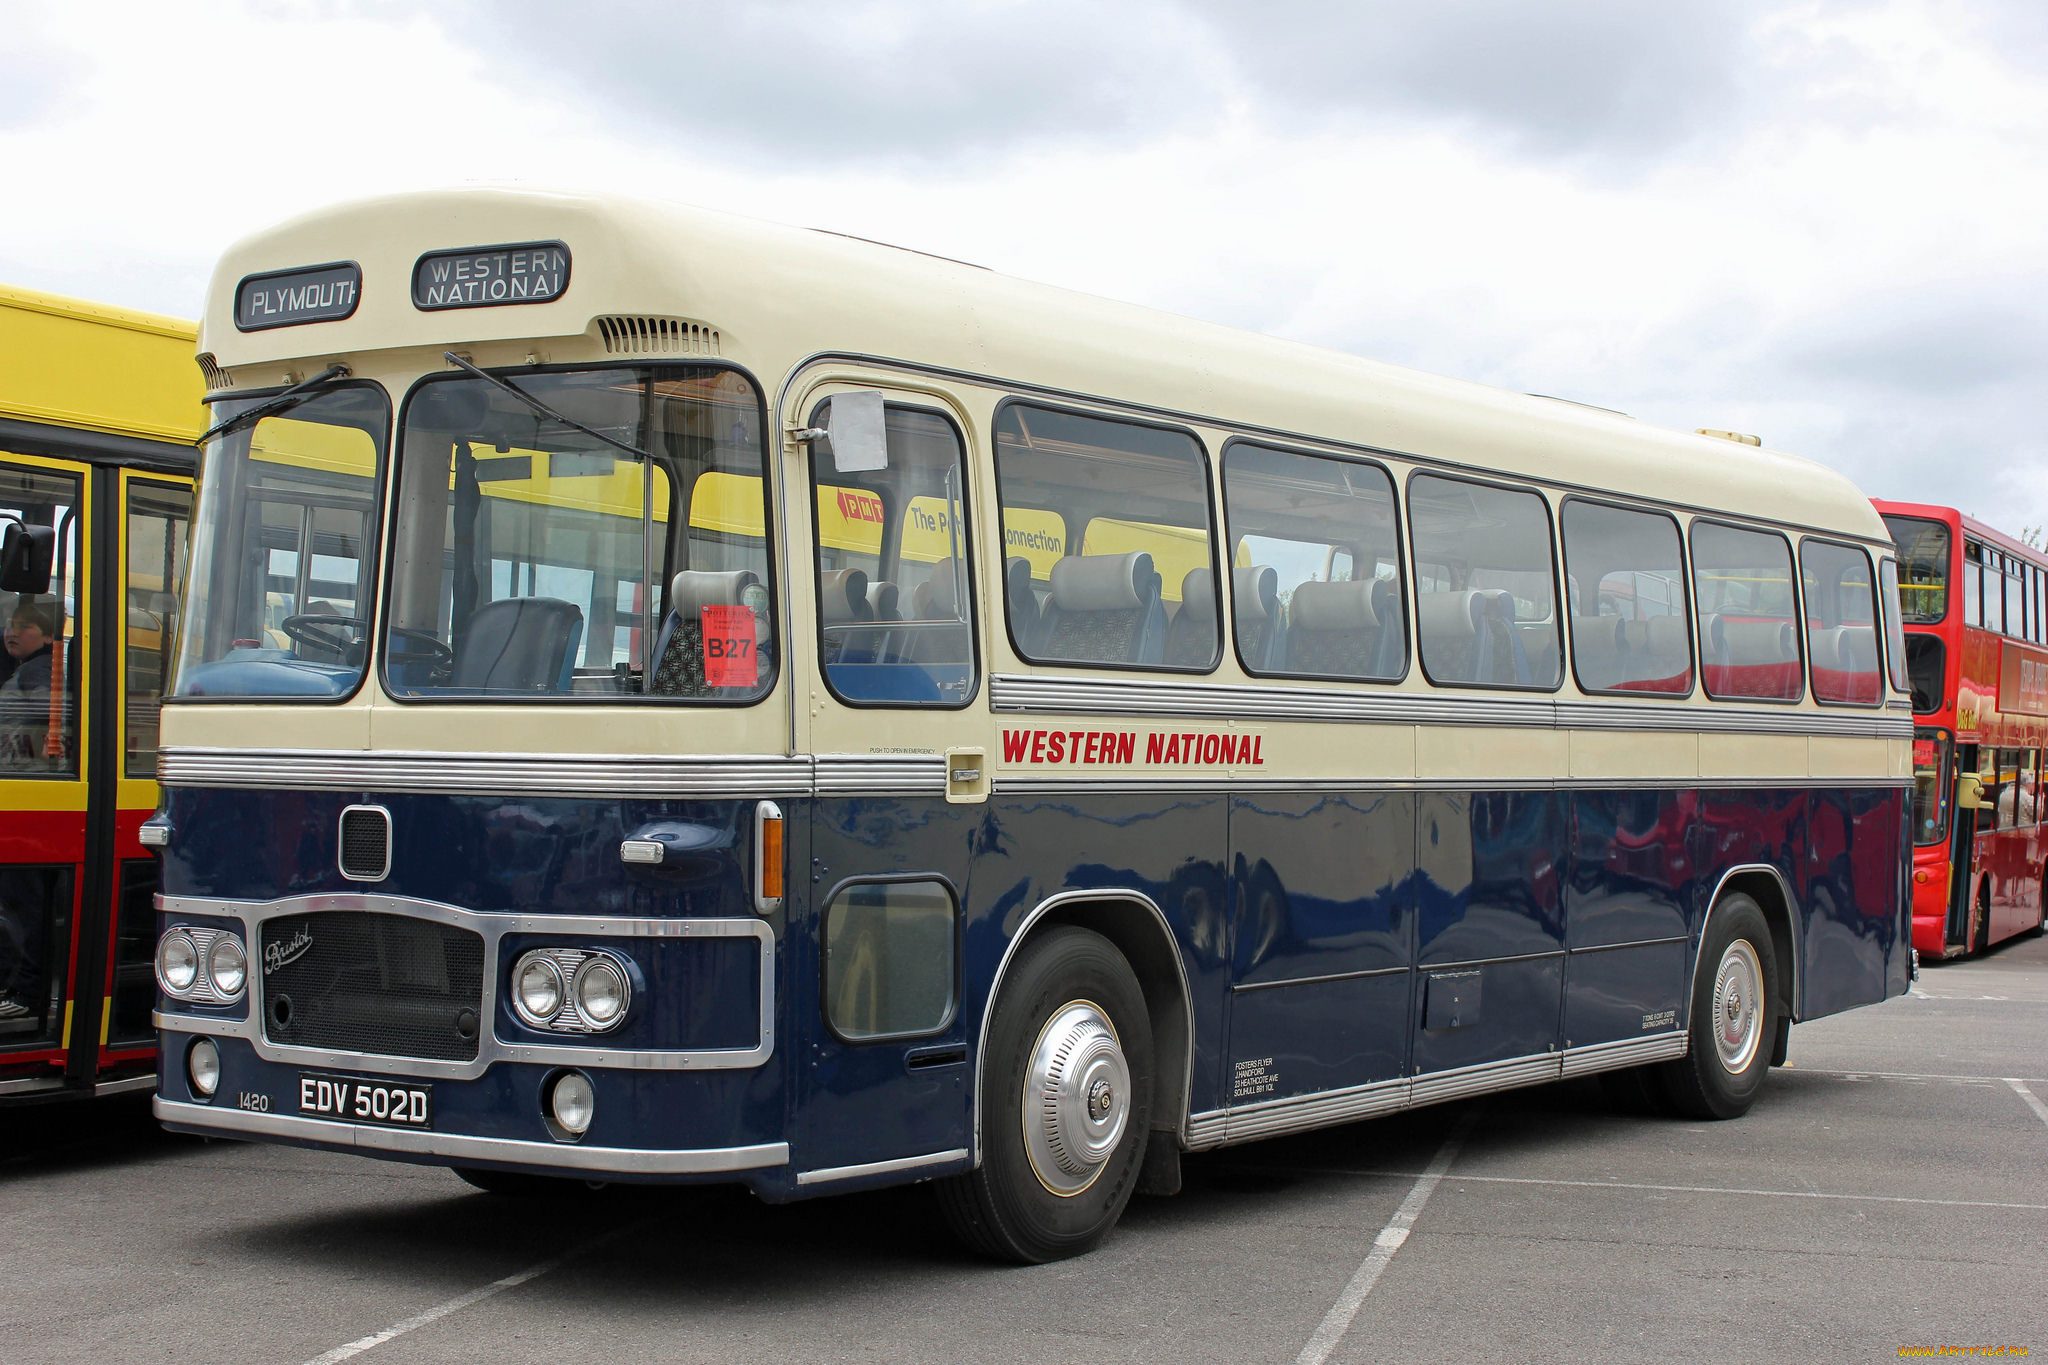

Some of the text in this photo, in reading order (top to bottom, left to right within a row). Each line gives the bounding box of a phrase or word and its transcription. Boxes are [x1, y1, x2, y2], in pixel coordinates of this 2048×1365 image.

[430, 251, 565, 283] WESTERN
[848, 498, 884, 520] PMT
[911, 507, 936, 532] The
[1005, 528, 1062, 553] onnection
[708, 638, 751, 659] B27
[908, 747, 936, 755] EMERGENCY
[1002, 729, 1265, 765] WESTERN NATIONAL
[264, 922, 313, 975] Bristol
[1235, 1058, 1273, 1070] FOSTERS FLYER
[1234, 1086, 1256, 1097] SOLIHULL
[1240, 1075, 1269, 1088] HEATHCOTE
[1269, 1074, 1279, 1082] AVE
[239, 1091, 268, 1112] 1420
[301, 1078, 427, 1123] EDV 502D
